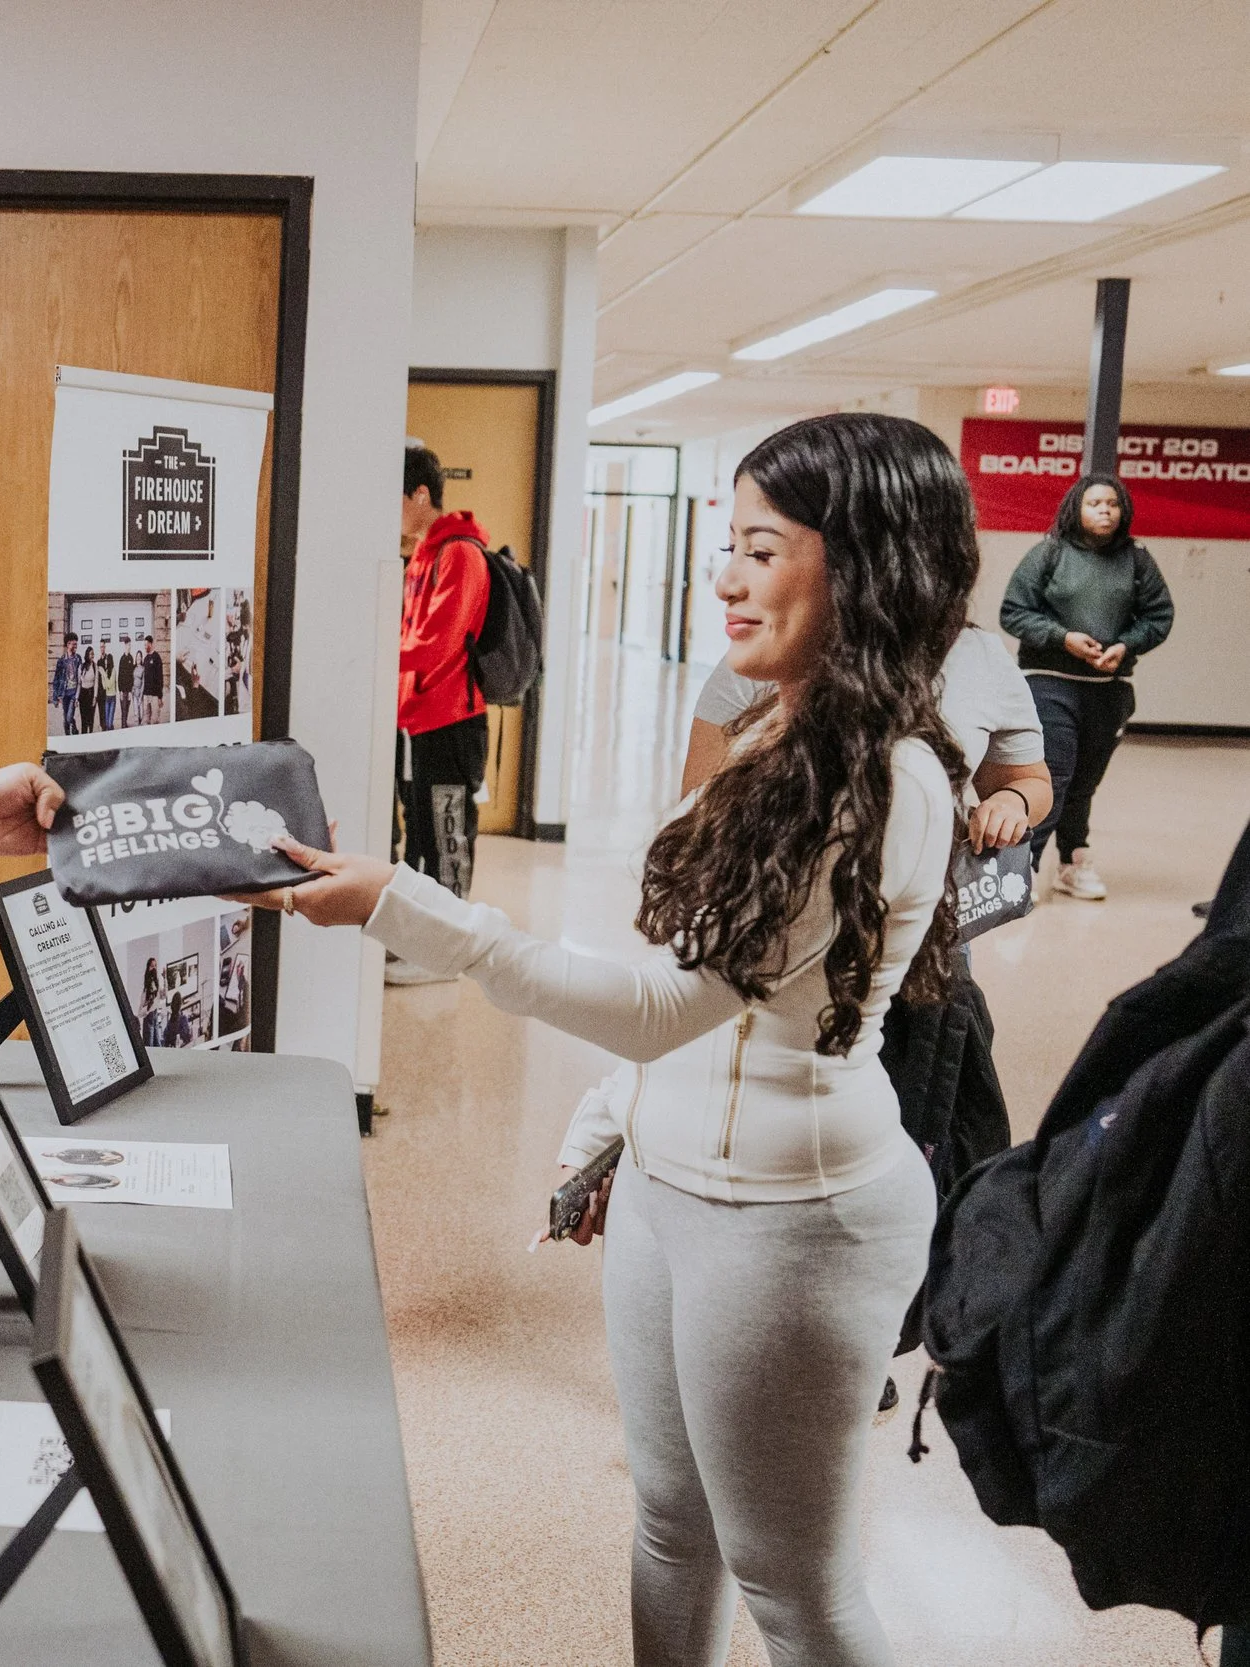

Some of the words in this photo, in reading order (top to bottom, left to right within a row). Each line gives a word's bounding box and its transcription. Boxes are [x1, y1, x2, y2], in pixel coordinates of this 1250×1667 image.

[1039, 433, 1159, 456] DISICT
[1162, 438, 1219, 458] 209
[163, 455, 179, 470] THE
[979, 454, 1076, 477] BOARD
[134, 476, 204, 503] FIREHOUSE
[147, 510, 191, 535] DREAM
[72, 805, 110, 828] BAG
[111, 794, 213, 835] BIG
[76, 818, 113, 845] OF
[80, 828, 220, 868] FEELINGS
[957, 875, 997, 912] BIG
[957, 897, 1003, 928] ELINGS
[29, 920, 56, 937] CALLING
[56, 917, 67, 928] ALL
[37, 932, 71, 953] CREATIVES!
